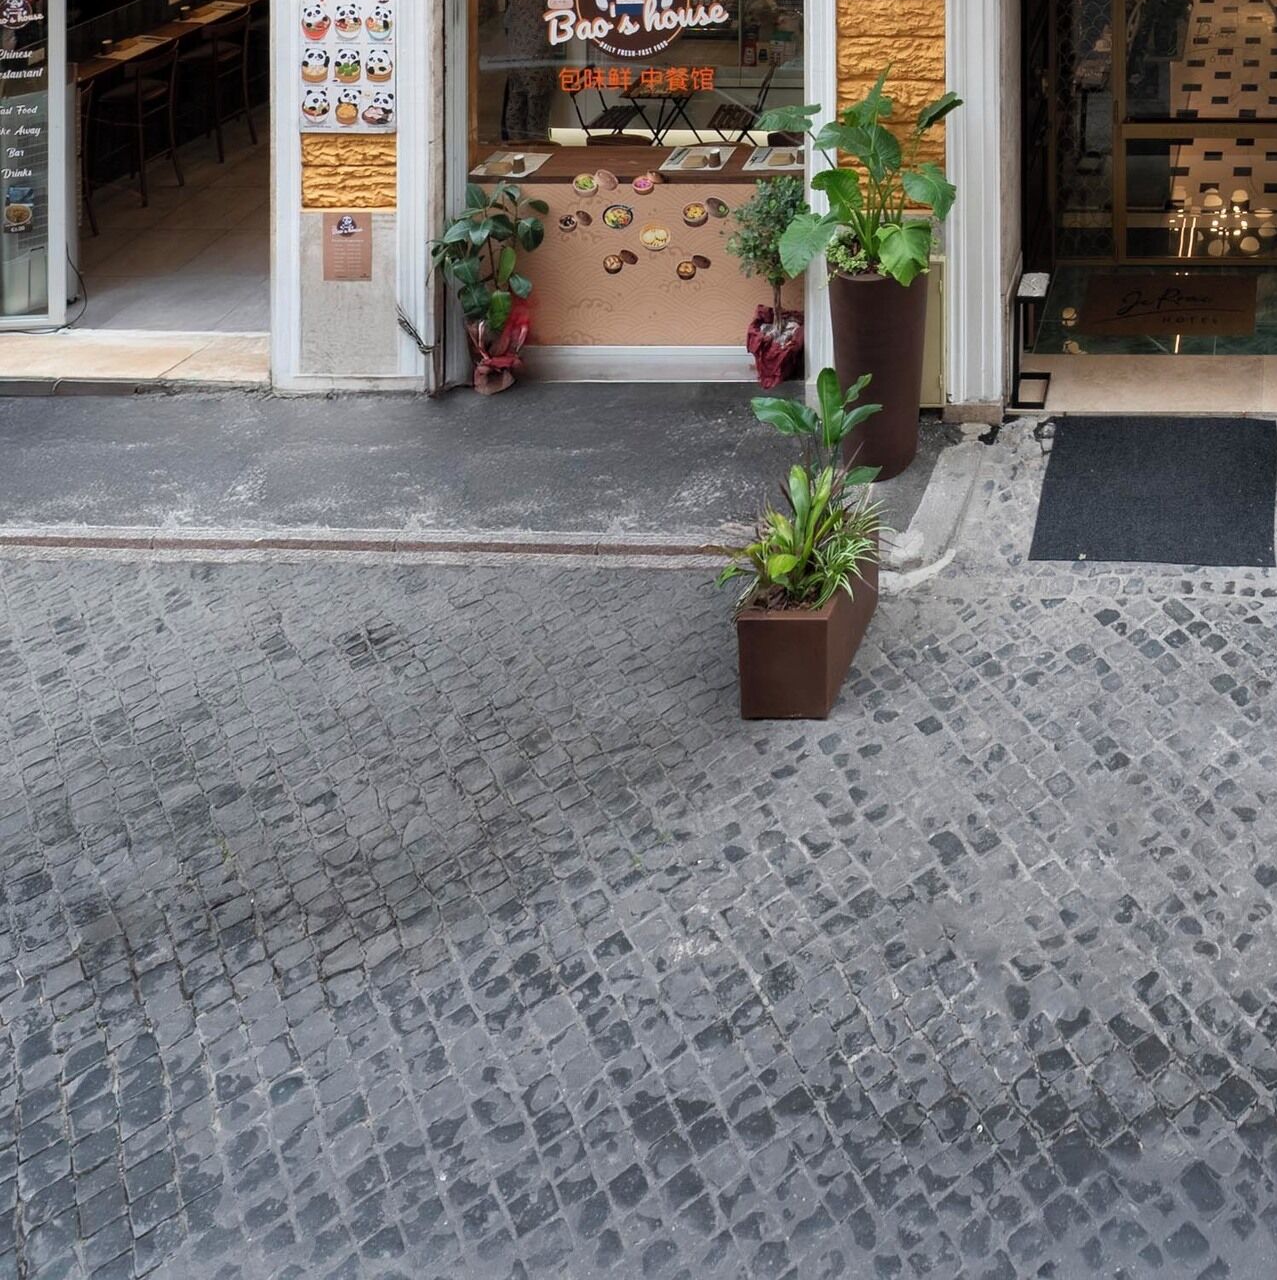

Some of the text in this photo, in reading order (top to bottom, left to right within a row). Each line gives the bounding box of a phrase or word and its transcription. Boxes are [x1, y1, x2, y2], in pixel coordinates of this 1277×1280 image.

[543, 2, 640, 46] Bao's
[559, 67, 714, 91] 包味鲜 中餐馆
[16, 104, 38, 115] Food
[14, 125, 41, 137] Away
[6, 147, 24, 158] Bar
[1, 168, 32, 179] Drinks
